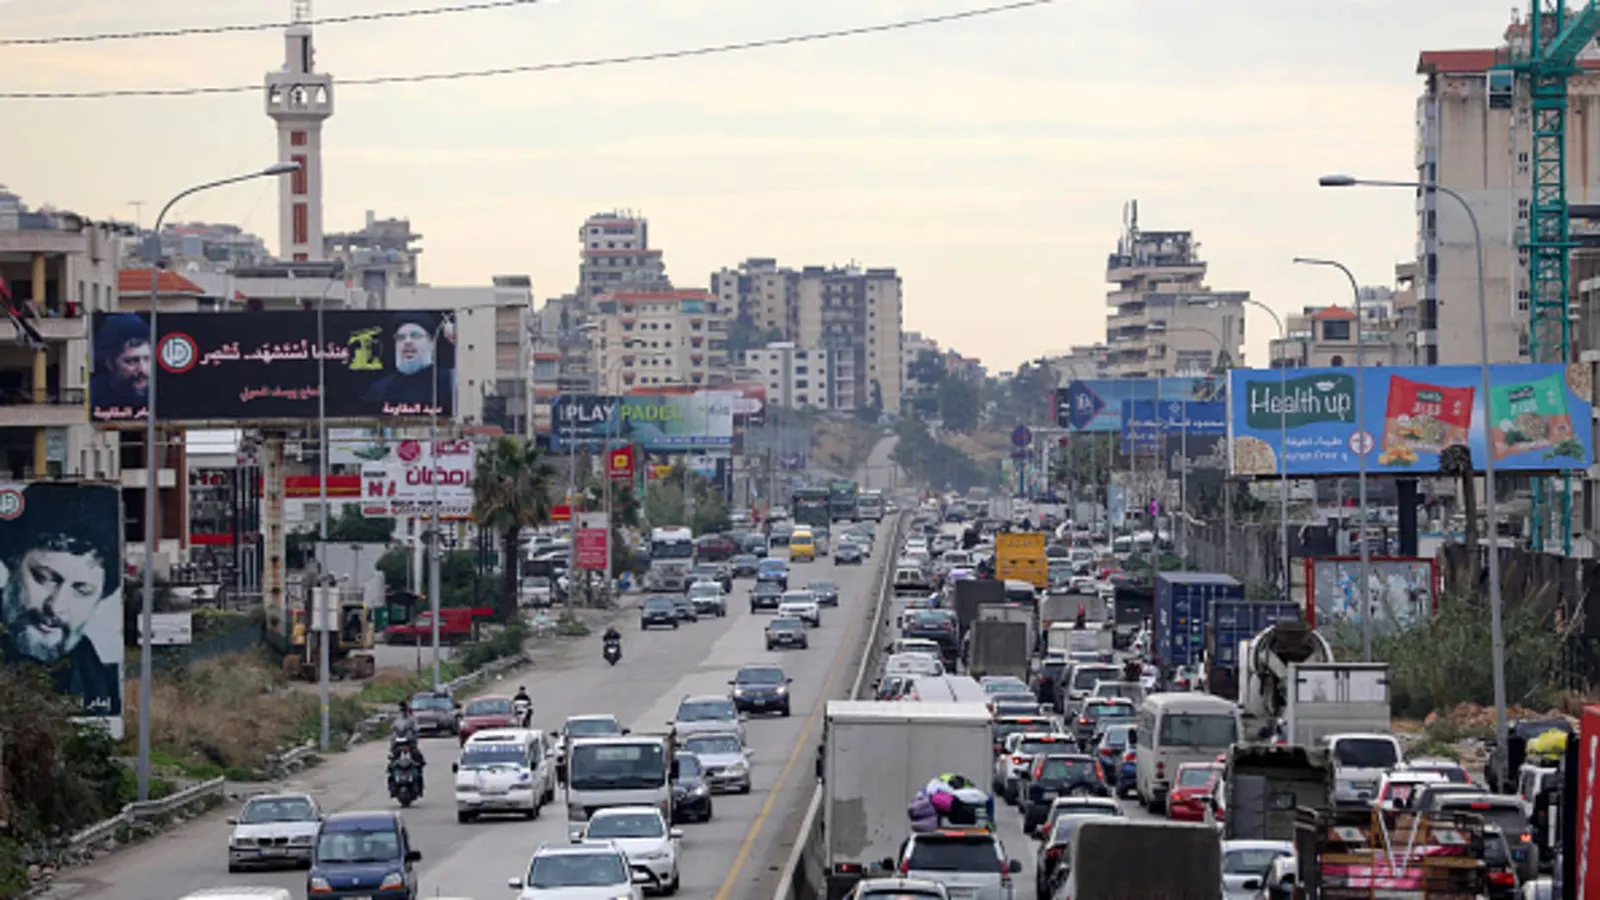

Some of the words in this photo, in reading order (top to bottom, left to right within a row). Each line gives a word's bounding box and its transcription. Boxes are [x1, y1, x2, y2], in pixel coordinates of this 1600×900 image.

[621, 403, 681, 421] PADEL
[1250, 386, 1321, 416] Health
[1324, 392, 1352, 421] up
